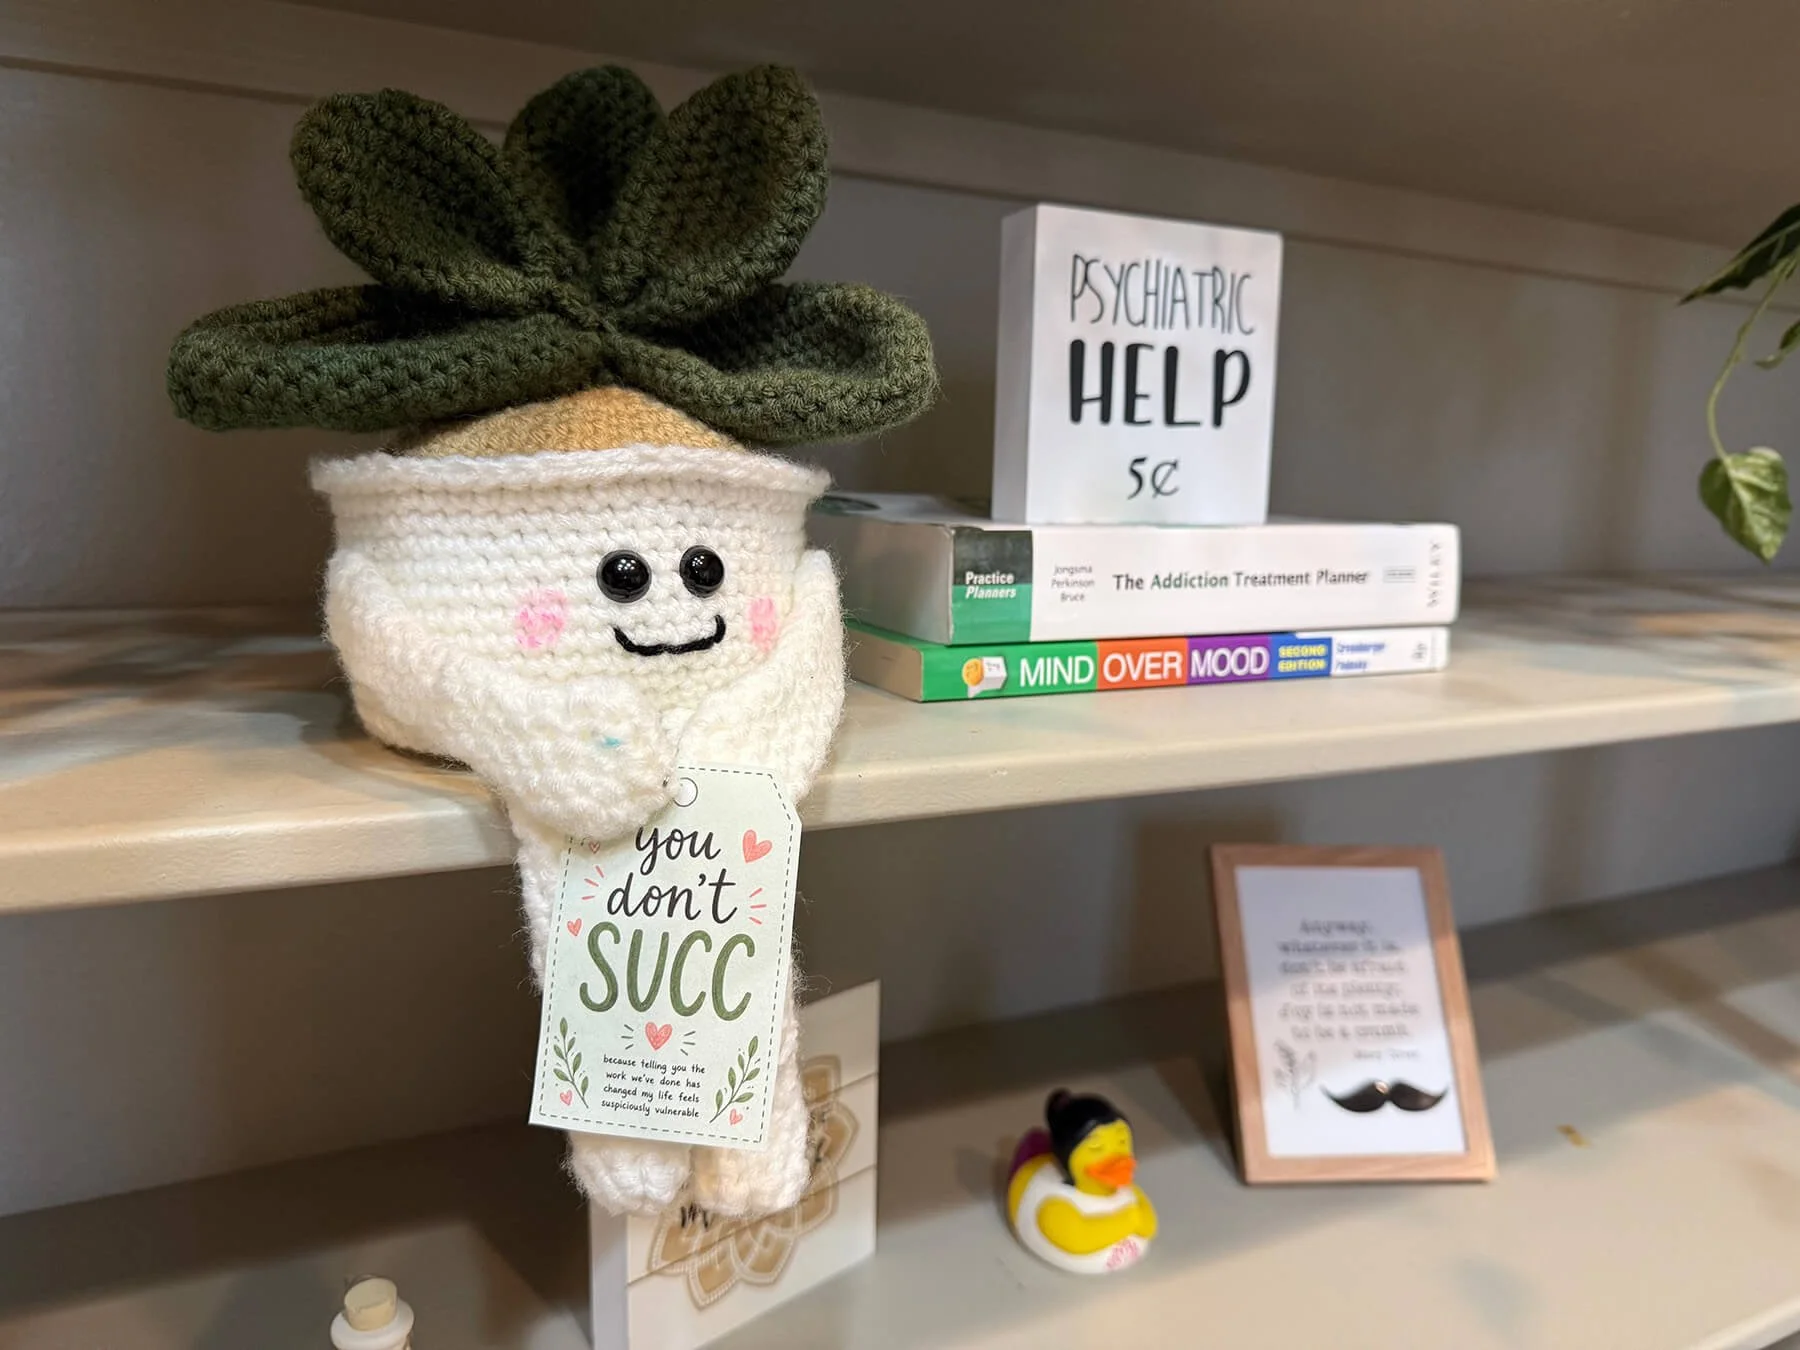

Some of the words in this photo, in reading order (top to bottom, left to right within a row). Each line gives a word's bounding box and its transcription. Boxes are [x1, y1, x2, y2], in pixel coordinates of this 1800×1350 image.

[1070, 253, 1254, 335] PSYCHIATRIC
[1069, 339, 1251, 429] HELP
[1127, 456, 1179, 500] 5¢
[964, 571, 1015, 585] Practice
[1053, 565, 1093, 576] Jongsma
[1112, 573, 1145, 590] The
[1151, 571, 1229, 589] Addiction
[1233, 570, 1310, 587] Treatment
[1315, 568, 1369, 585] Planner
[964, 586, 1017, 599] Planners
[1060, 592, 1086, 602] Bruce
[1019, 655, 1095, 688] MIND
[1103, 651, 1183, 683] OVER
[1190, 646, 1270, 678] MOOD
[634, 826, 721, 876] you
[606, 868, 738, 924] don't
[579, 921, 756, 1021] SUCC
[603, 1054, 637, 1067] because
[641, 1059, 667, 1074] telling
[671, 1064, 687, 1075] you
[691, 1063, 705, 1074] the
[606, 1071, 626, 1080] work
[631, 1073, 655, 1084] we've
[660, 1076, 681, 1087] done
[686, 1078, 701, 1088] has
[603, 1084, 637, 1098] changed
[641, 1091, 654, 1102] my
[658, 1090, 673, 1101] life
[679, 1092, 700, 1103] feels
[601, 1099, 650, 1116] suspiciously
[655, 1106, 700, 1118] vulnerable
